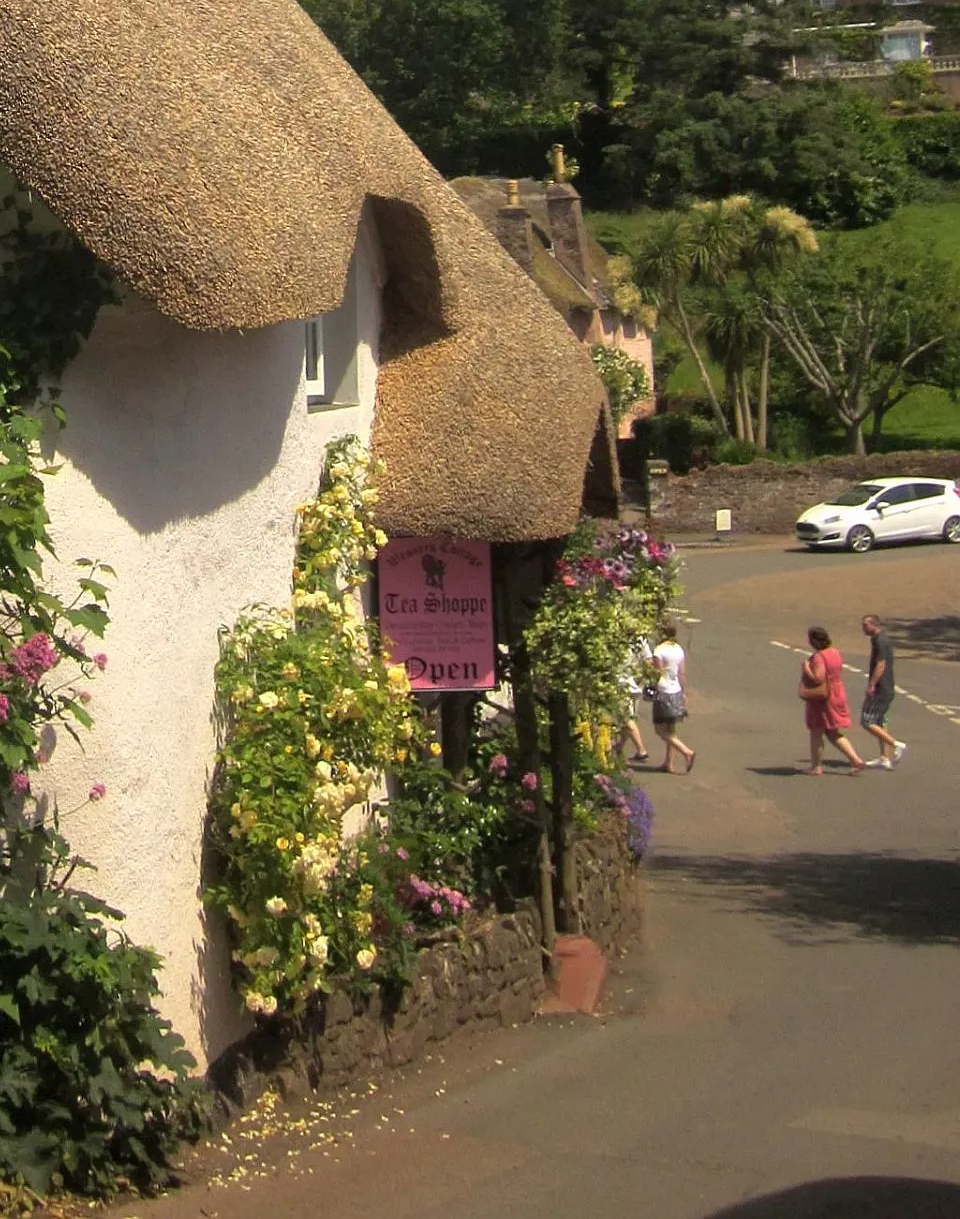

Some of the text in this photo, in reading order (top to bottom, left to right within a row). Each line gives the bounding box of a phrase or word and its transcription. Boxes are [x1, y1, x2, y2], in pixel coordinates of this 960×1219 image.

[385, 592, 486, 616] Tea Shoppe
[404, 656, 479, 684] Open
